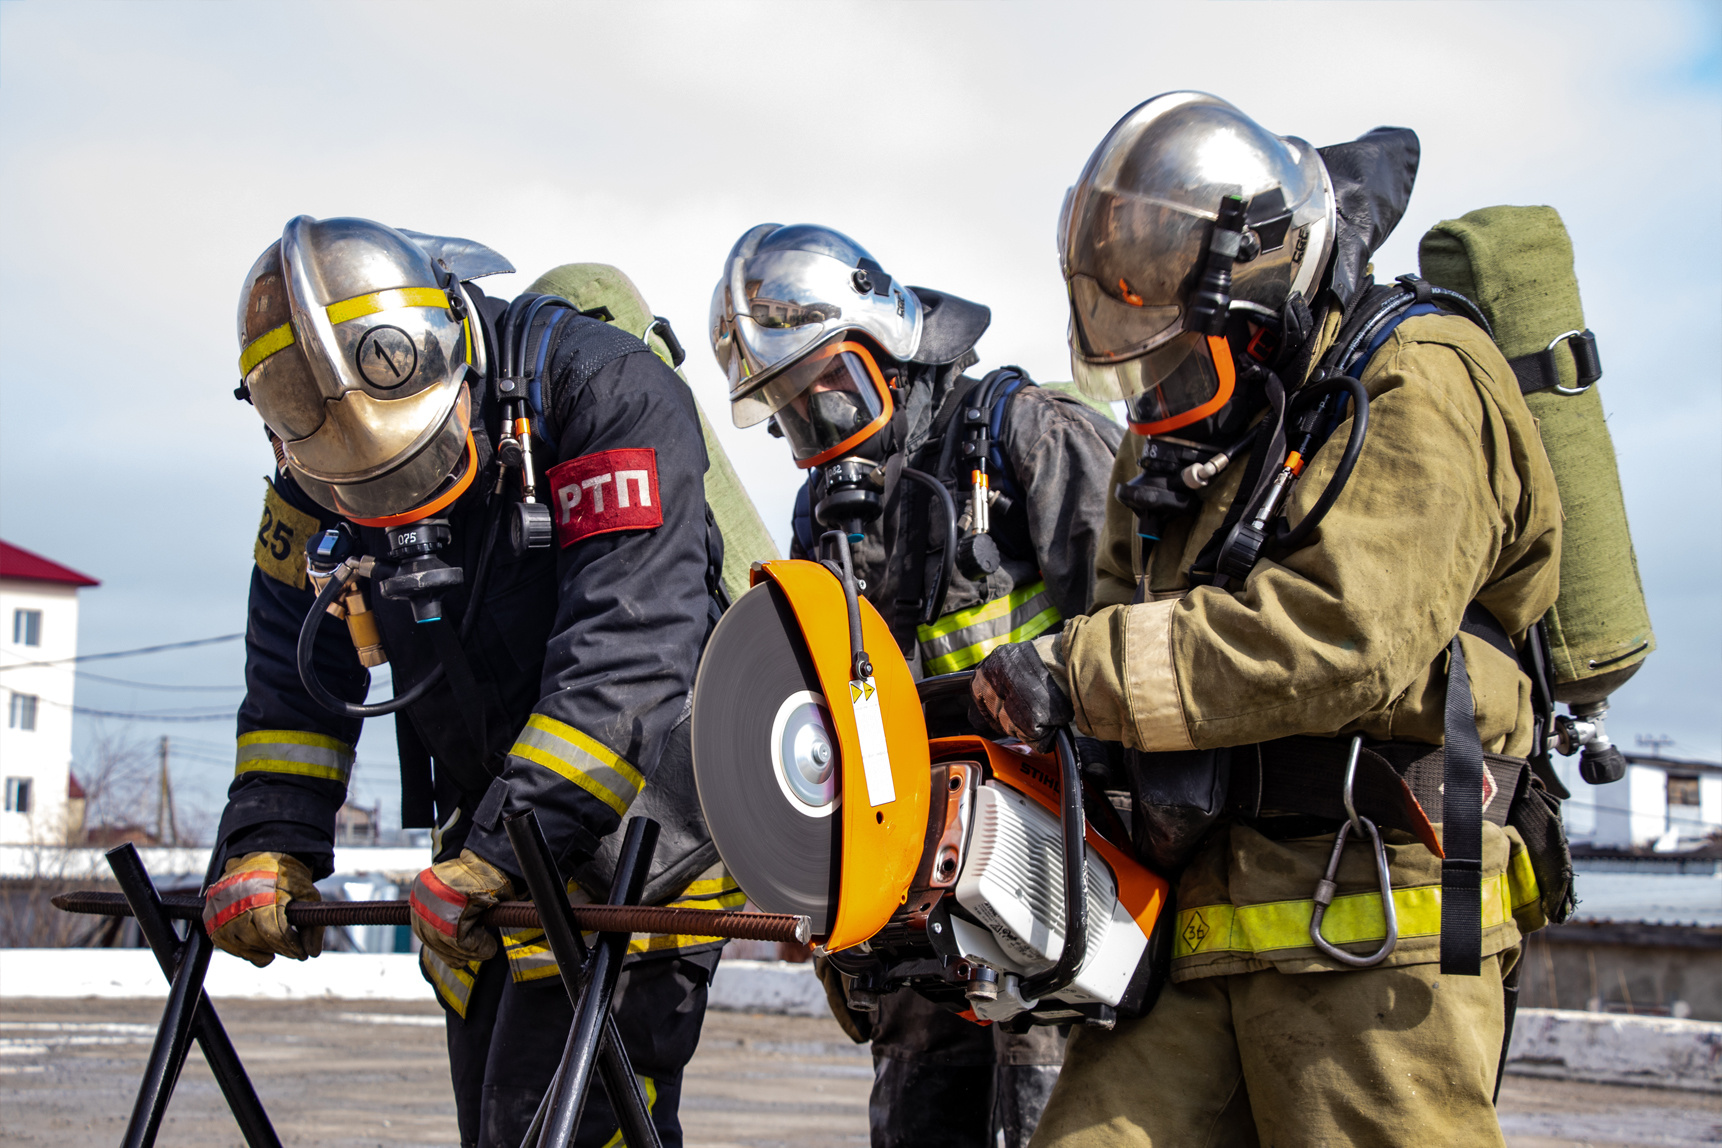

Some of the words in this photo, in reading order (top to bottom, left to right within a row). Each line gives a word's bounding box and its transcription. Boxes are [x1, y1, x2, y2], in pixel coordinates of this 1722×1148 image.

[558, 469, 652, 525] РТП
[258, 505, 294, 561] 25
[398, 532, 417, 545] 075
[1020, 762, 1060, 794] STIHL
[1189, 924, 1205, 940] 36
